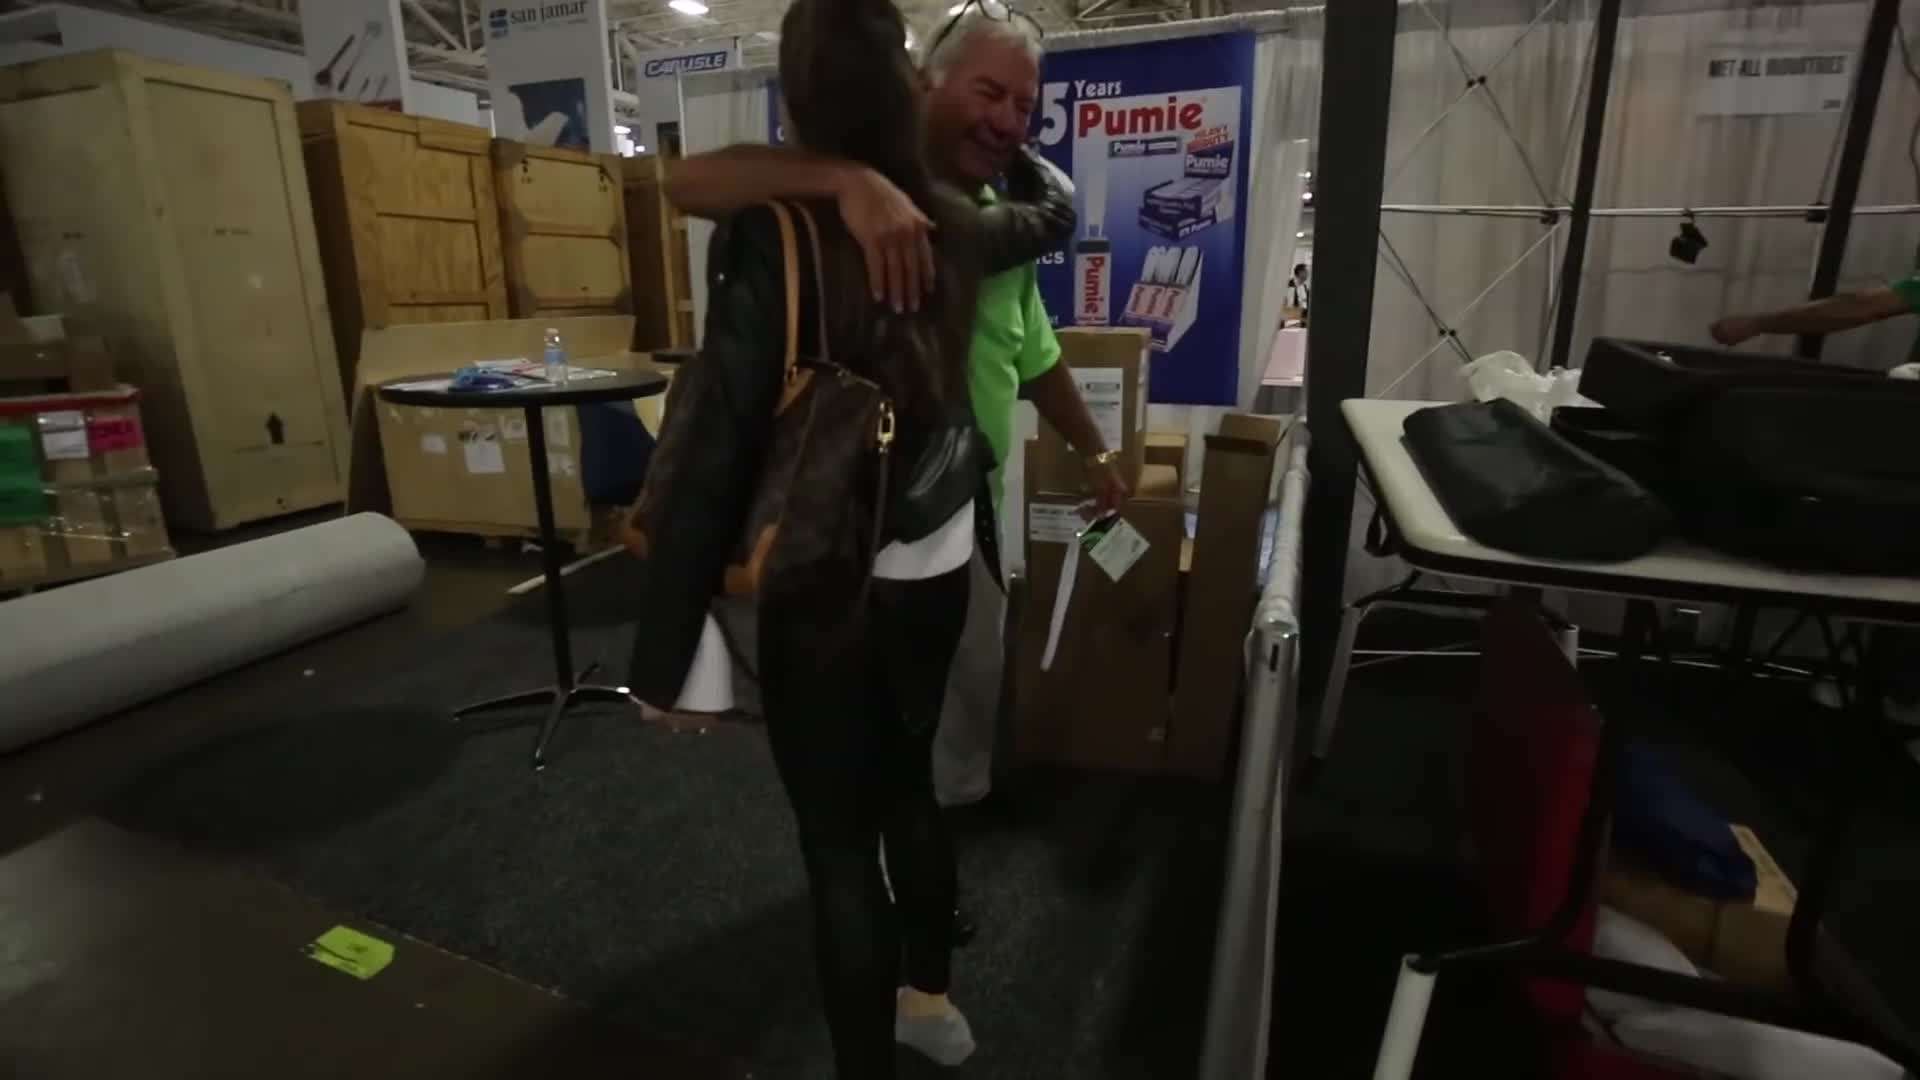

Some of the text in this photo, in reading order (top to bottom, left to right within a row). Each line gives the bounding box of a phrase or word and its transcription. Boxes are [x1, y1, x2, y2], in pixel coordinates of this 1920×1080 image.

[511, 0, 588, 24] san jamar
[645, 51, 726, 77] CARLISLE
[1074, 80, 1122, 98] Years
[1078, 96, 1203, 138] Pumie
[1186, 153, 1229, 169] Pumie
[1085, 256, 1104, 315] Pumie
